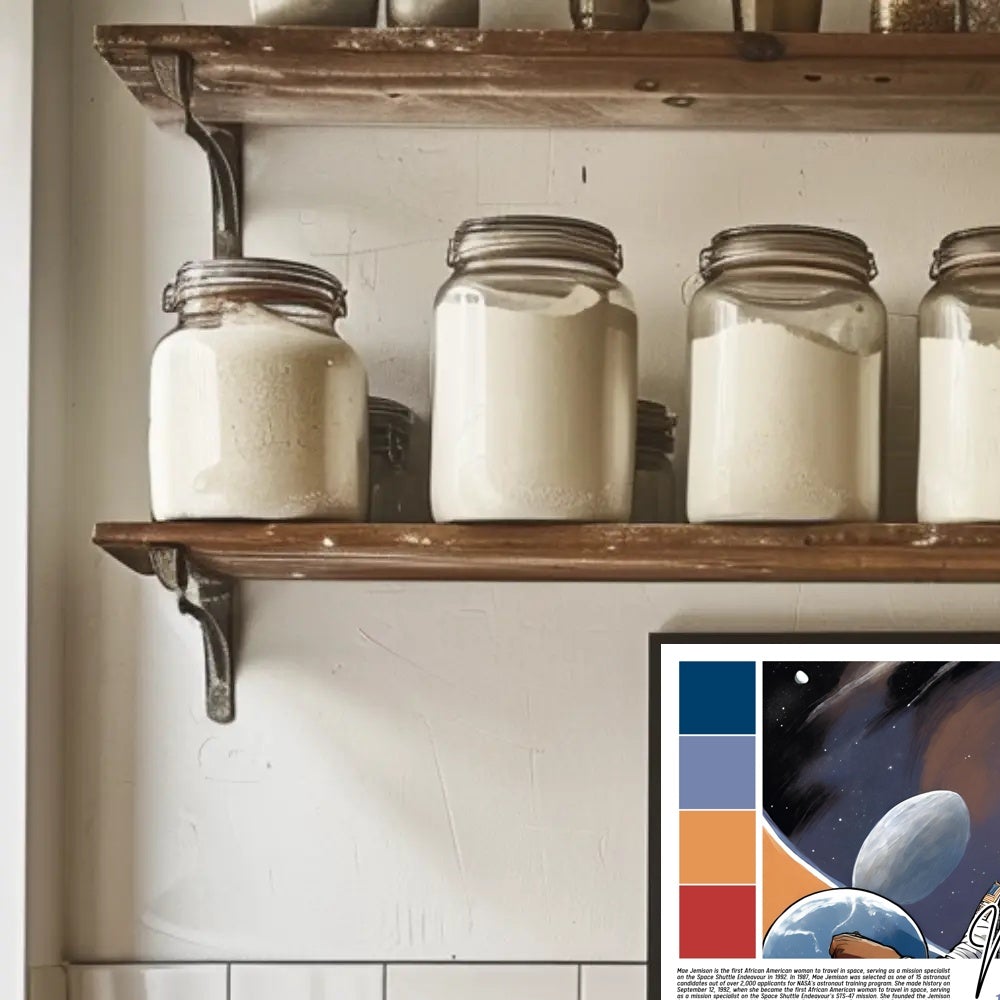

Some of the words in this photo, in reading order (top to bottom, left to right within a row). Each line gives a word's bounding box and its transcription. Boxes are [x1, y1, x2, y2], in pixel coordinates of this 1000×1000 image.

[757, 980, 786, 988] applicants
[844, 980, 867, 988] training
[922, 980, 942, 988] history
